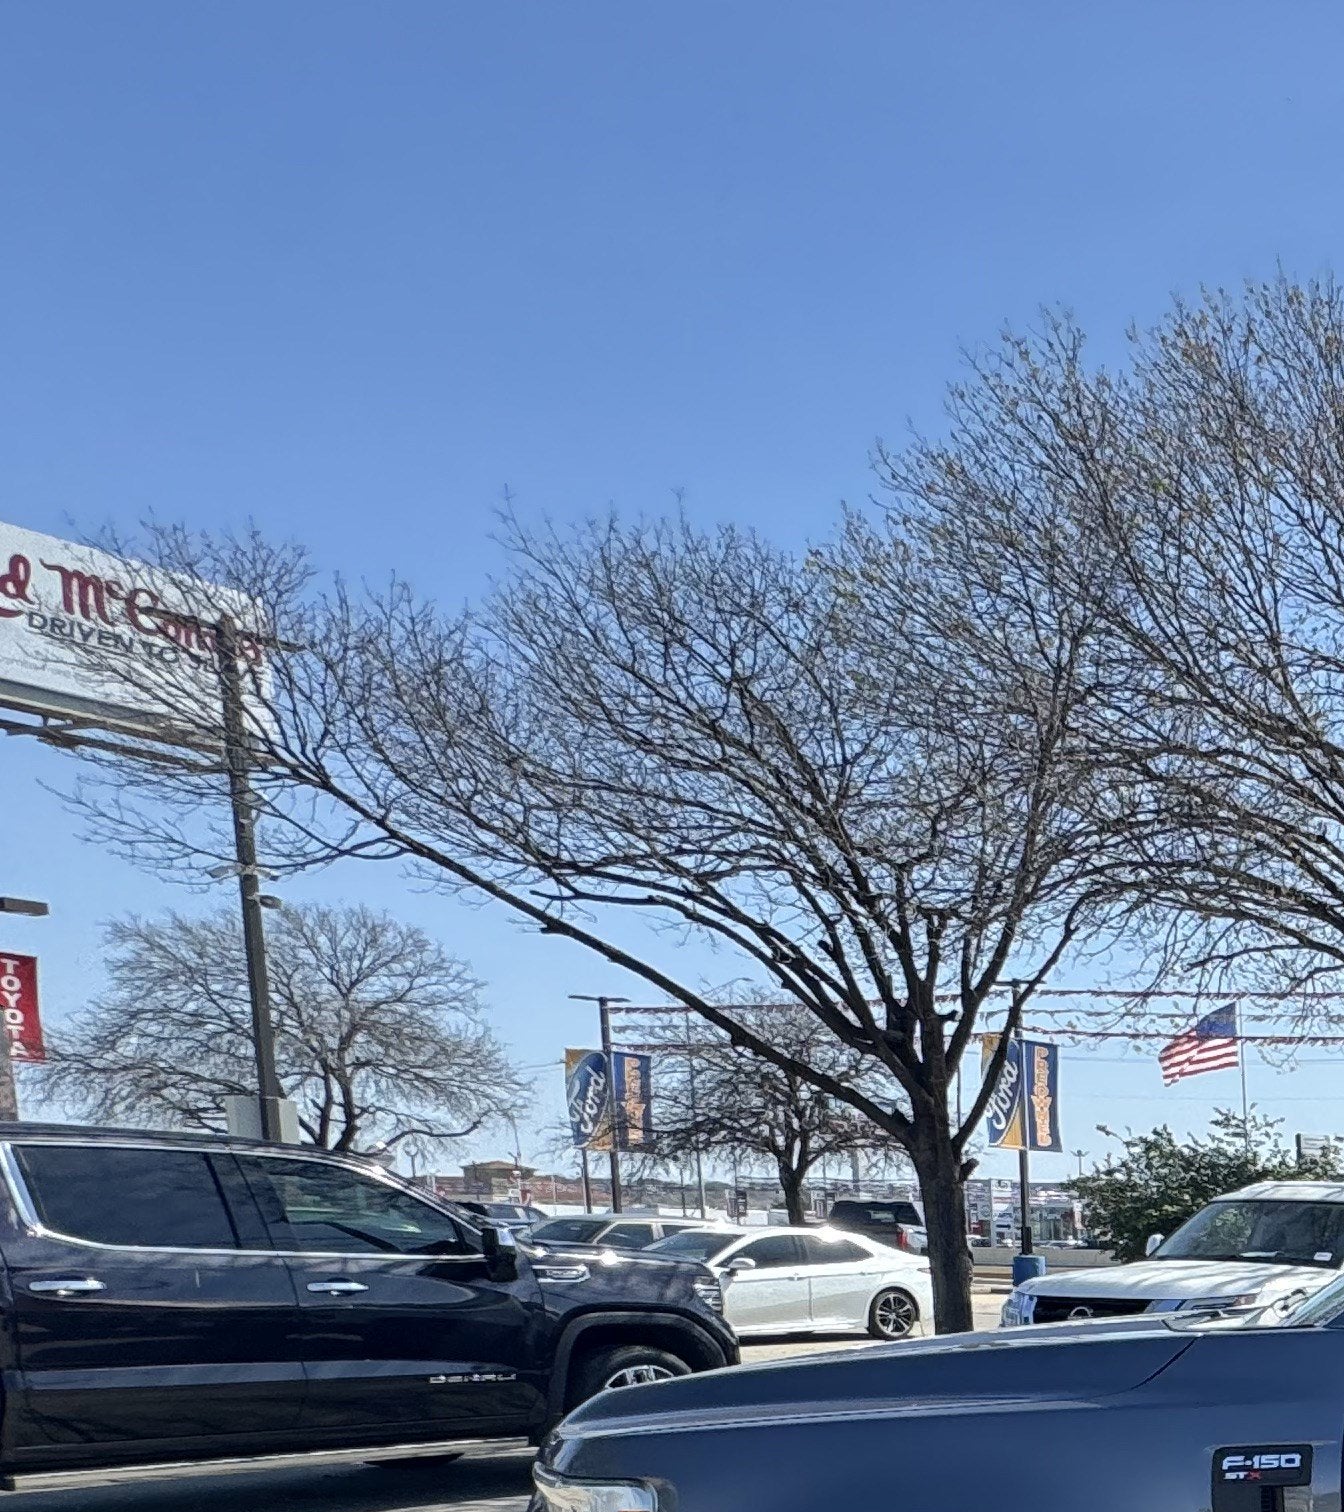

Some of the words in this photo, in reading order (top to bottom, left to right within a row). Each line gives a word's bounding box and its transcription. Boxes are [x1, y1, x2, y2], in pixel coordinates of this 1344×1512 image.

[27, 612, 135, 651] DRIVEN
[0, 957, 29, 1057] TOYOTA
[568, 1064, 606, 1134] Ford
[985, 1059, 1019, 1130] Ford
[1221, 1453, 1302, 1471] F-150
[1223, 1470, 1262, 1480] STX
